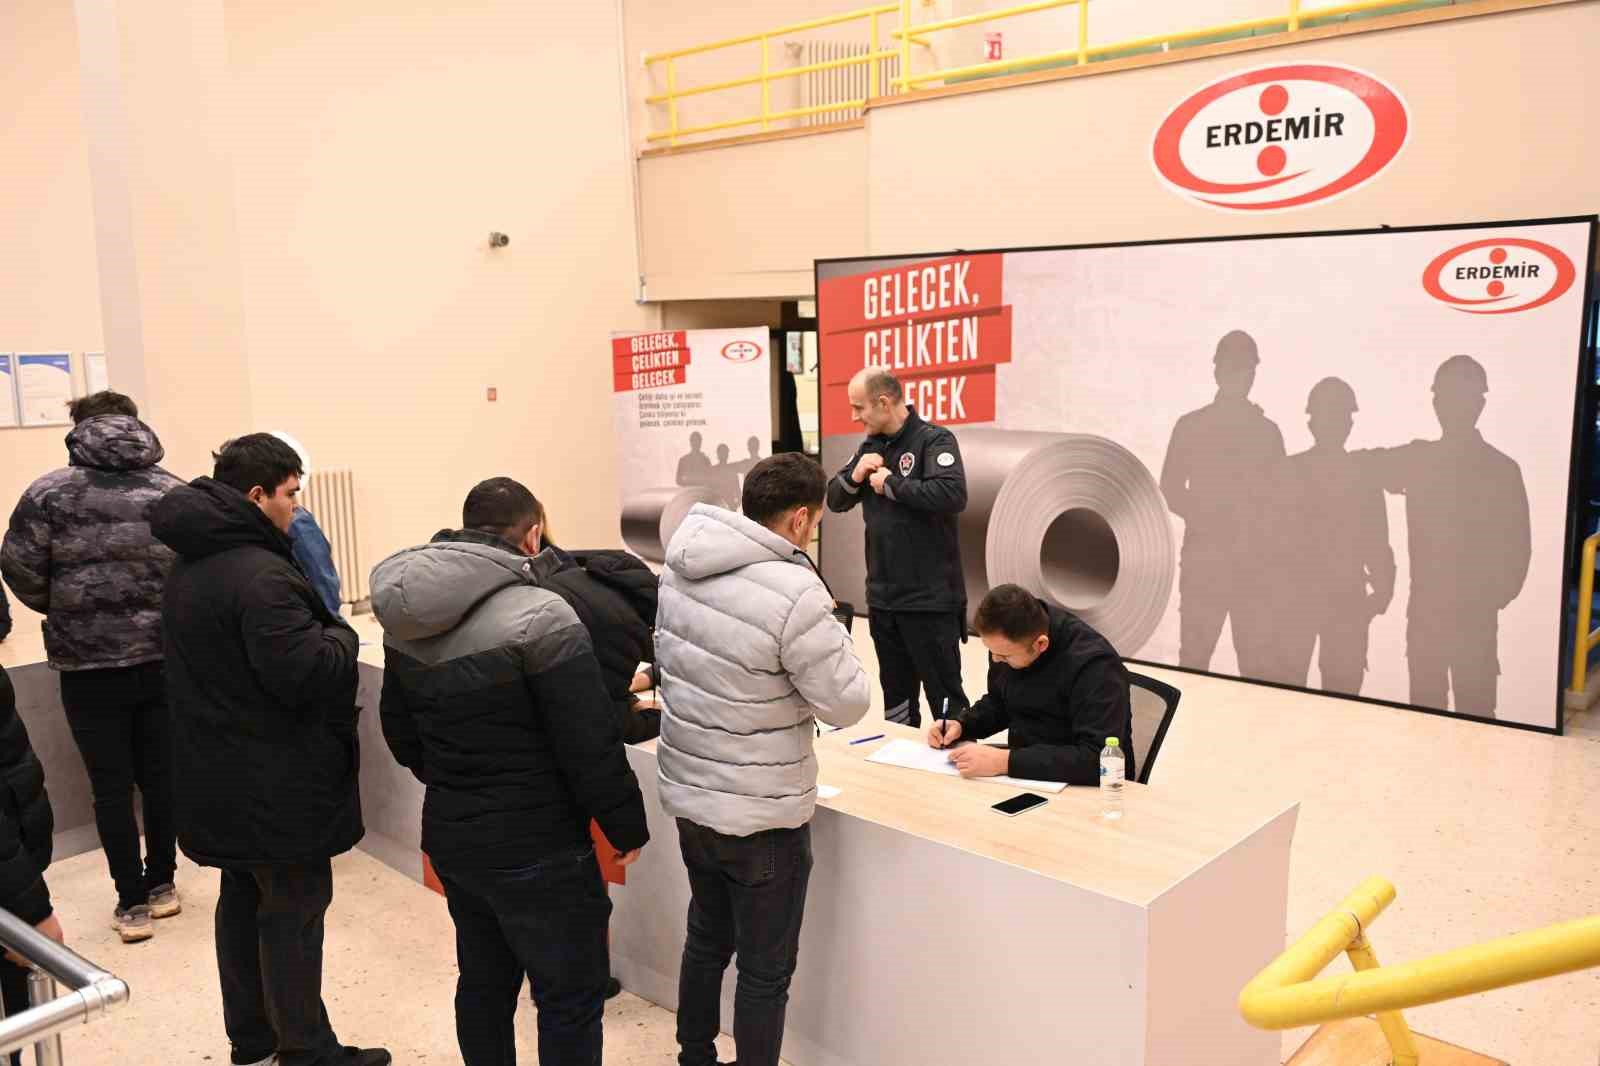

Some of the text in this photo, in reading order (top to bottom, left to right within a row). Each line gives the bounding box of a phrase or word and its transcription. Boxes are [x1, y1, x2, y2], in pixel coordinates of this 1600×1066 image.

[1205, 107, 1345, 148] ERDEMİR
[864, 261, 980, 320] GELECEK,
[1455, 261, 1540, 280] ERDEMİR
[631, 369, 676, 389] GELECEK
[904, 376, 967, 422] ECEK
